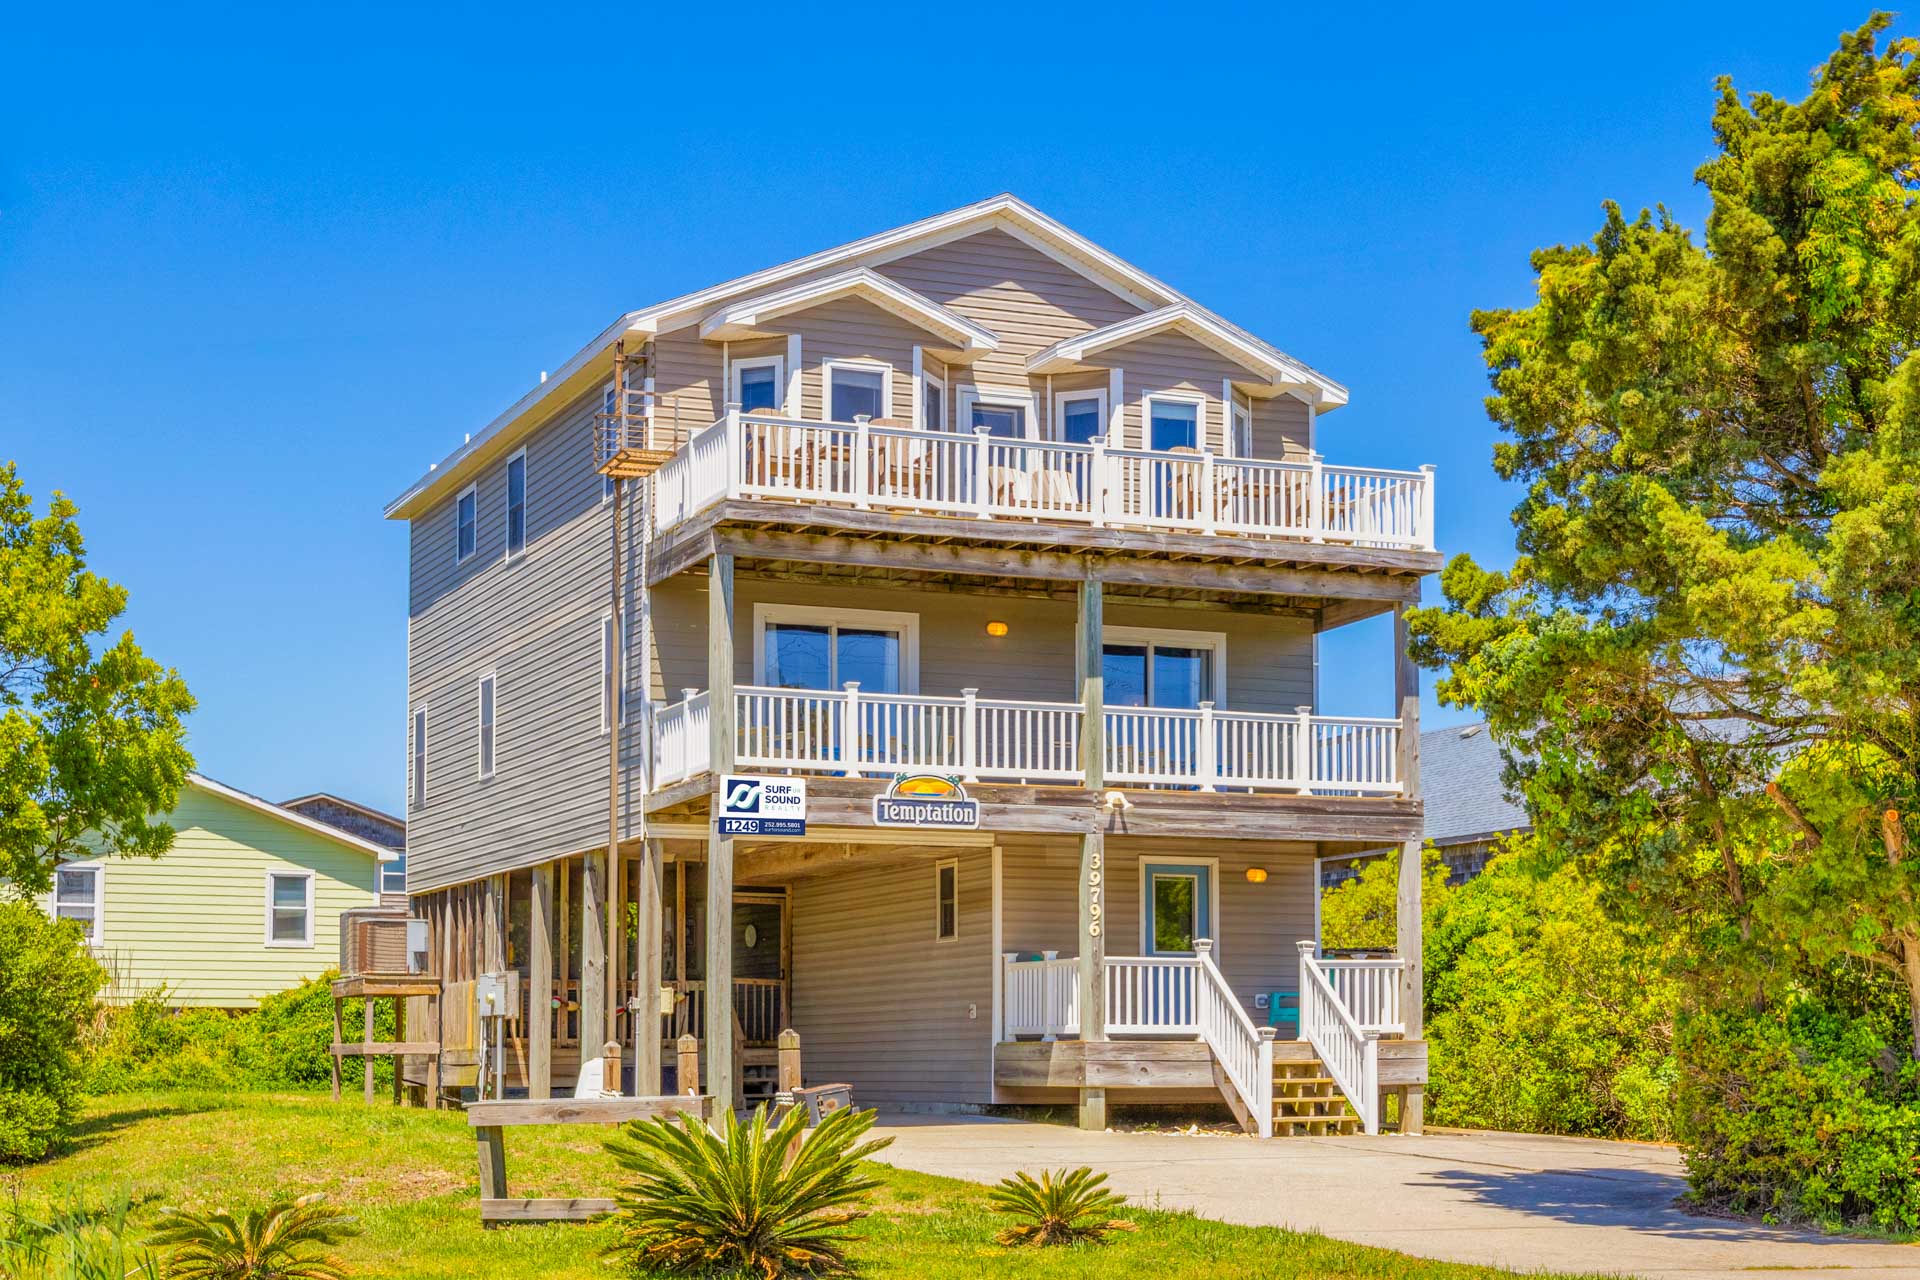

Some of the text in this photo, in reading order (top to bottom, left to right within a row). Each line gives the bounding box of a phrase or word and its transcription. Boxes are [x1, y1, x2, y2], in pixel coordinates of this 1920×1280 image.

[765, 785, 792, 794] SURF
[765, 795, 801, 804] SOUND
[765, 804, 801, 812] REALTY
[880, 801, 974, 825] Temptation
[726, 820, 759, 832] 1249
[1088, 853, 1101, 937] 39796
